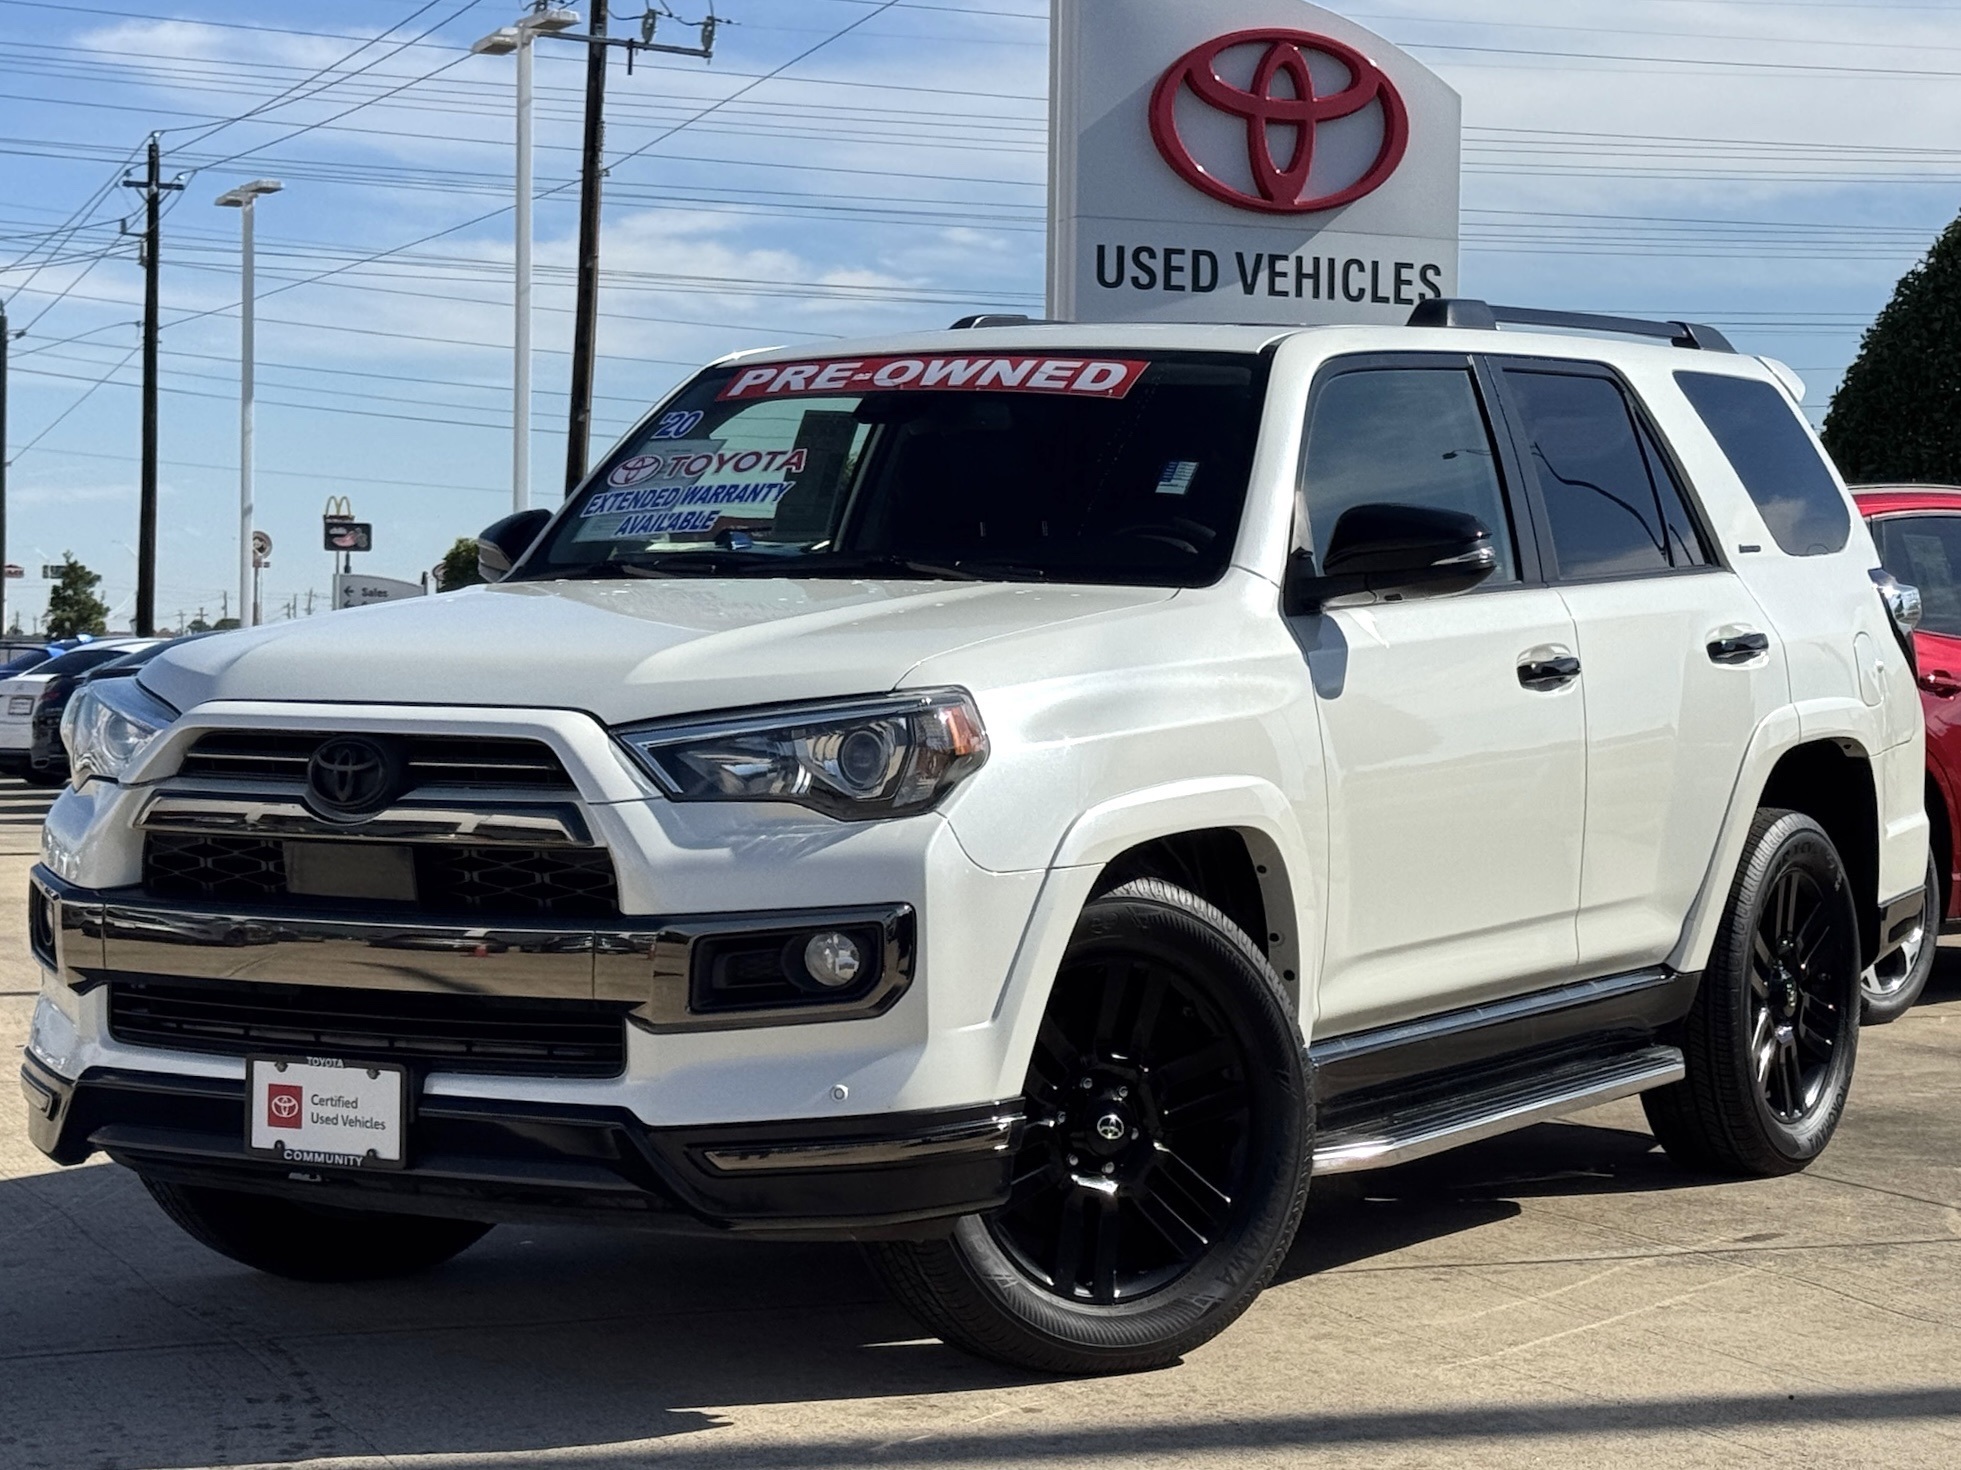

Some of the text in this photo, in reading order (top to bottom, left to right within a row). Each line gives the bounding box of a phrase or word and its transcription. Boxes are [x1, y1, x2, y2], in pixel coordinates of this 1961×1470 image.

[1096, 244, 1443, 306] USED VEHICLES
[727, 359, 1128, 397] PRE-OWNED
[666, 448, 807, 477] TOYOTA
[582, 482, 794, 516] EXTENDED WARRANTY
[615, 510, 721, 536] AVAILABLE
[361, 587, 389, 598] Sales
[306, 1056, 344, 1068] TOYOTA
[311, 1094, 358, 1109] Certified
[311, 1112, 386, 1130] Used Vehicles
[283, 1150, 362, 1167] COMMUNITY
